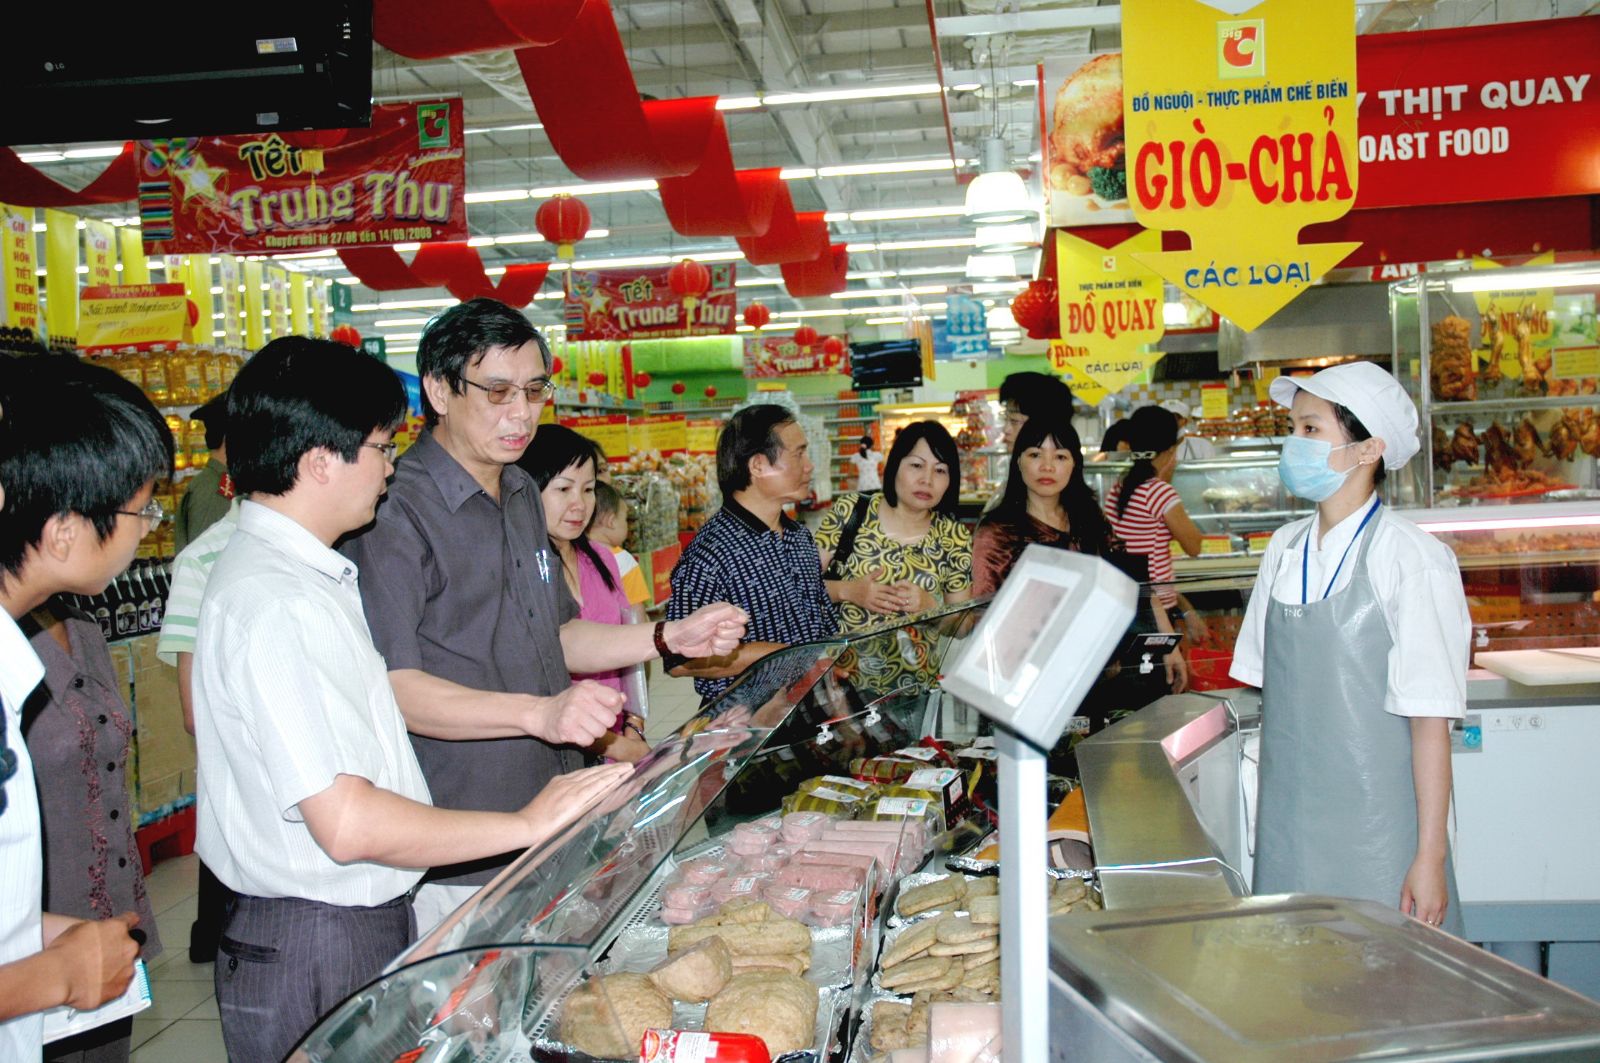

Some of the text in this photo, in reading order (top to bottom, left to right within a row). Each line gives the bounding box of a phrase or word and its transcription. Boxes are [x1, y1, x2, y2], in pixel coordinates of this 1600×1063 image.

[1220, 26, 1257, 67] Big C
[1154, 90, 1193, 113] NGUỘI
[1207, 91, 1240, 111] THỰC
[1244, 81, 1283, 106] PHẨM
[1286, 79, 1312, 101] CHẾ
[1316, 76, 1349, 100] BIẾN
[1378, 84, 1469, 121] THỊT
[1480, 74, 1591, 110] QUAY
[1135, 105, 1353, 210] GIÒ-CHẢ
[1358, 126, 1510, 163] OAST FOOD
[229, 170, 454, 236] Trung Thu
[1184, 260, 1311, 289] CÁC LOẠI
[612, 303, 679, 331] Trung
[1069, 291, 1158, 340] ĐỒ QUAY
